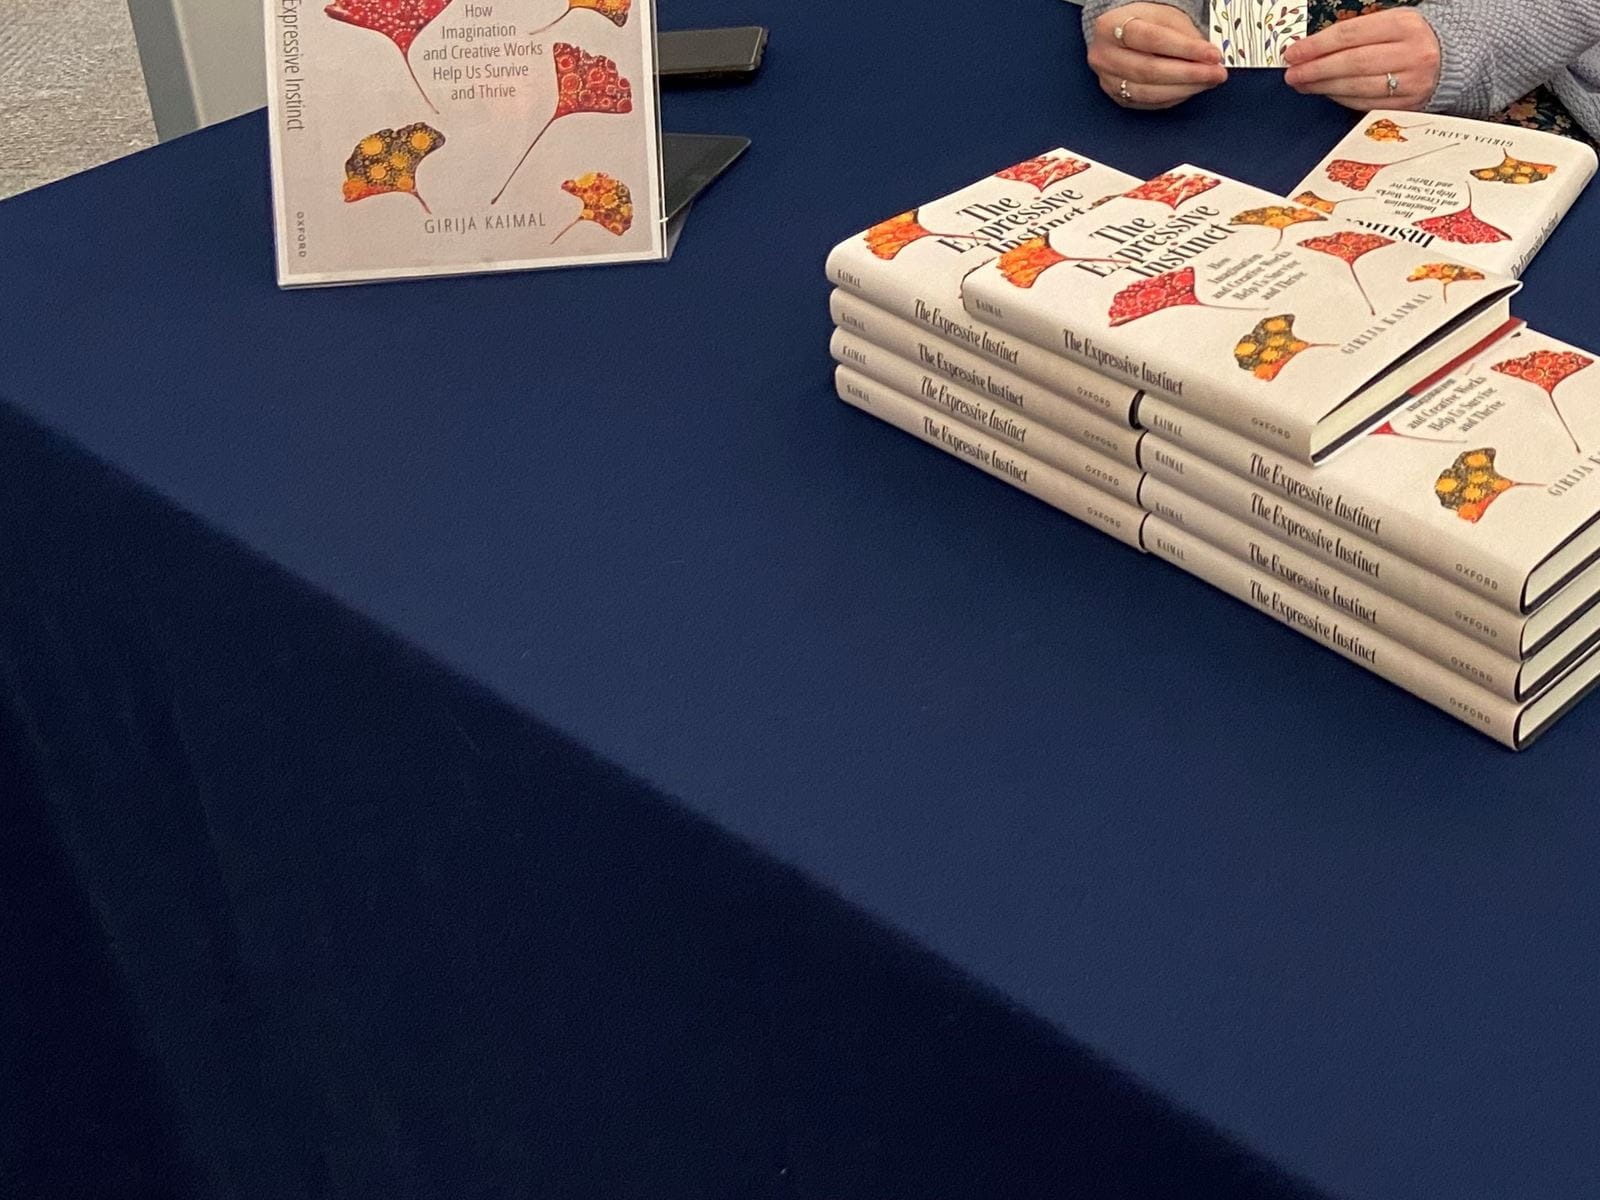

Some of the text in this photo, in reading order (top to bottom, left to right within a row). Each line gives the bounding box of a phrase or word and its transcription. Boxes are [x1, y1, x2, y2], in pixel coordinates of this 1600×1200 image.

[442, 24, 516, 42] Imagination
[465, 4, 492, 17] How
[424, 41, 542, 60] and Creative Works
[433, 64, 528, 84] Help Us Survive
[285, 78, 305, 132] Instinct
[451, 85, 516, 100] and Thrive
[1425, 128, 1514, 147] GIRIJA KAIMAL
[296, 211, 307, 258] OXFORD
[424, 212, 546, 235] GIRIJA KAIMAL
[937, 189, 1084, 254] Expressive
[956, 197, 1021, 222] The
[1089, 217, 1156, 245] The
[1074, 205, 1220, 278] Expressive
[1125, 222, 1238, 278] Instinct
[915, 299, 931, 322] The
[932, 307, 981, 346] Expressive
[982, 331, 1019, 365] Instinct
[1341, 294, 1432, 354] GIRIJA KAIMAL
[918, 343, 935, 364] The
[937, 350, 985, 390] Expressive
[988, 376, 1024, 408] Instinct
[1063, 328, 1083, 352] The
[1084, 337, 1139, 379] Expressive
[1142, 362, 1184, 395] Instinct
[1251, 417, 1291, 439] OXFORD
[921, 375, 938, 400] The
[939, 384, 988, 424] Expressive
[989, 409, 1027, 443] Instinct
[1085, 465, 1120, 487] OXFORD
[923, 416, 940, 438] The
[941, 424, 990, 464] Expressive
[992, 450, 1029, 483] Instinct
[1153, 415, 1499, 591] KAIMAL The Expressive Instinct OXFORD
[1548, 465, 1593, 496] GIRIJA
[1155, 450, 1498, 638] KAIMAL The Expressive Instinct OXFORD
[1249, 542, 1269, 567] The
[1271, 554, 1330, 600] Expressive
[1333, 586, 1377, 624] Instinct
[1451, 656, 1493, 683] OXFORD
[1250, 579, 1270, 606] The
[1272, 591, 1330, 639] Expressive
[1333, 624, 1377, 664] Instinct
[1450, 697, 1491, 724] OXFORD
